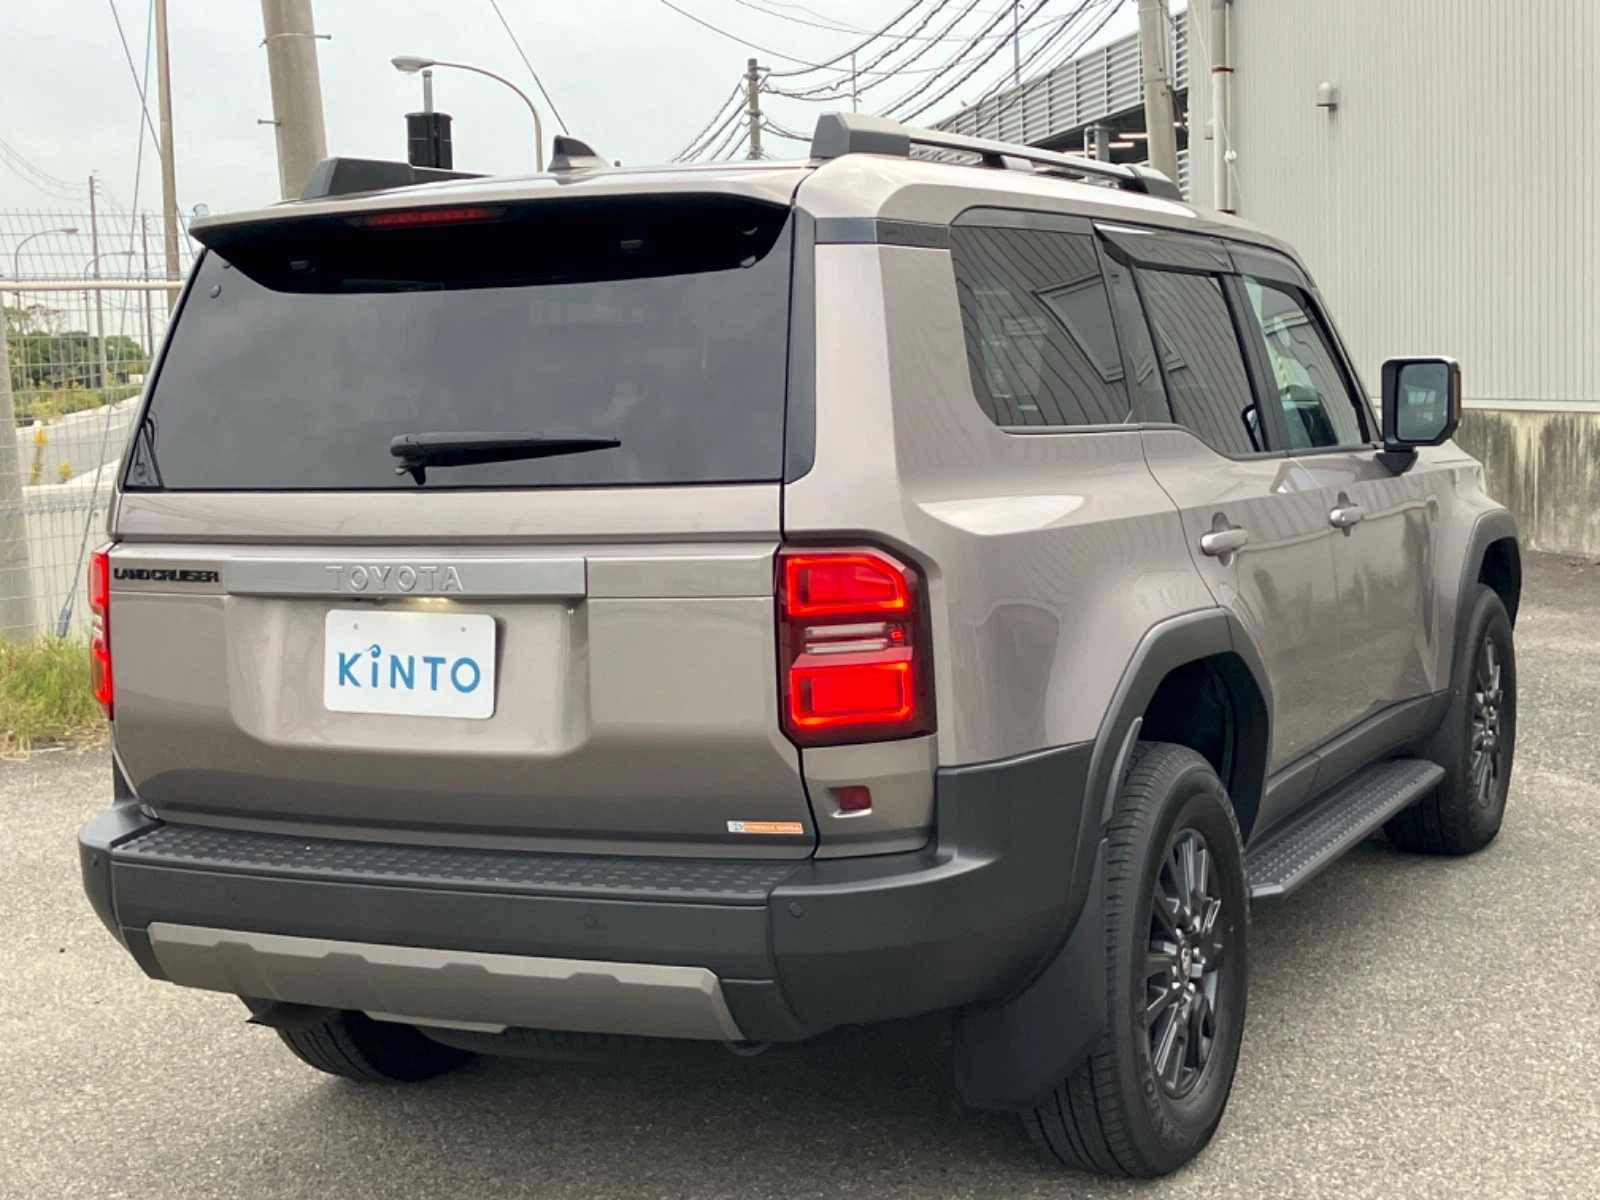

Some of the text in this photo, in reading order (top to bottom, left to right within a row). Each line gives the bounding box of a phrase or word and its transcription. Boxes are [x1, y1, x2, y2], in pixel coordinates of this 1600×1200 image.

[113, 568, 219, 582] LAND CRUISER
[325, 565, 464, 592] TOYOTA
